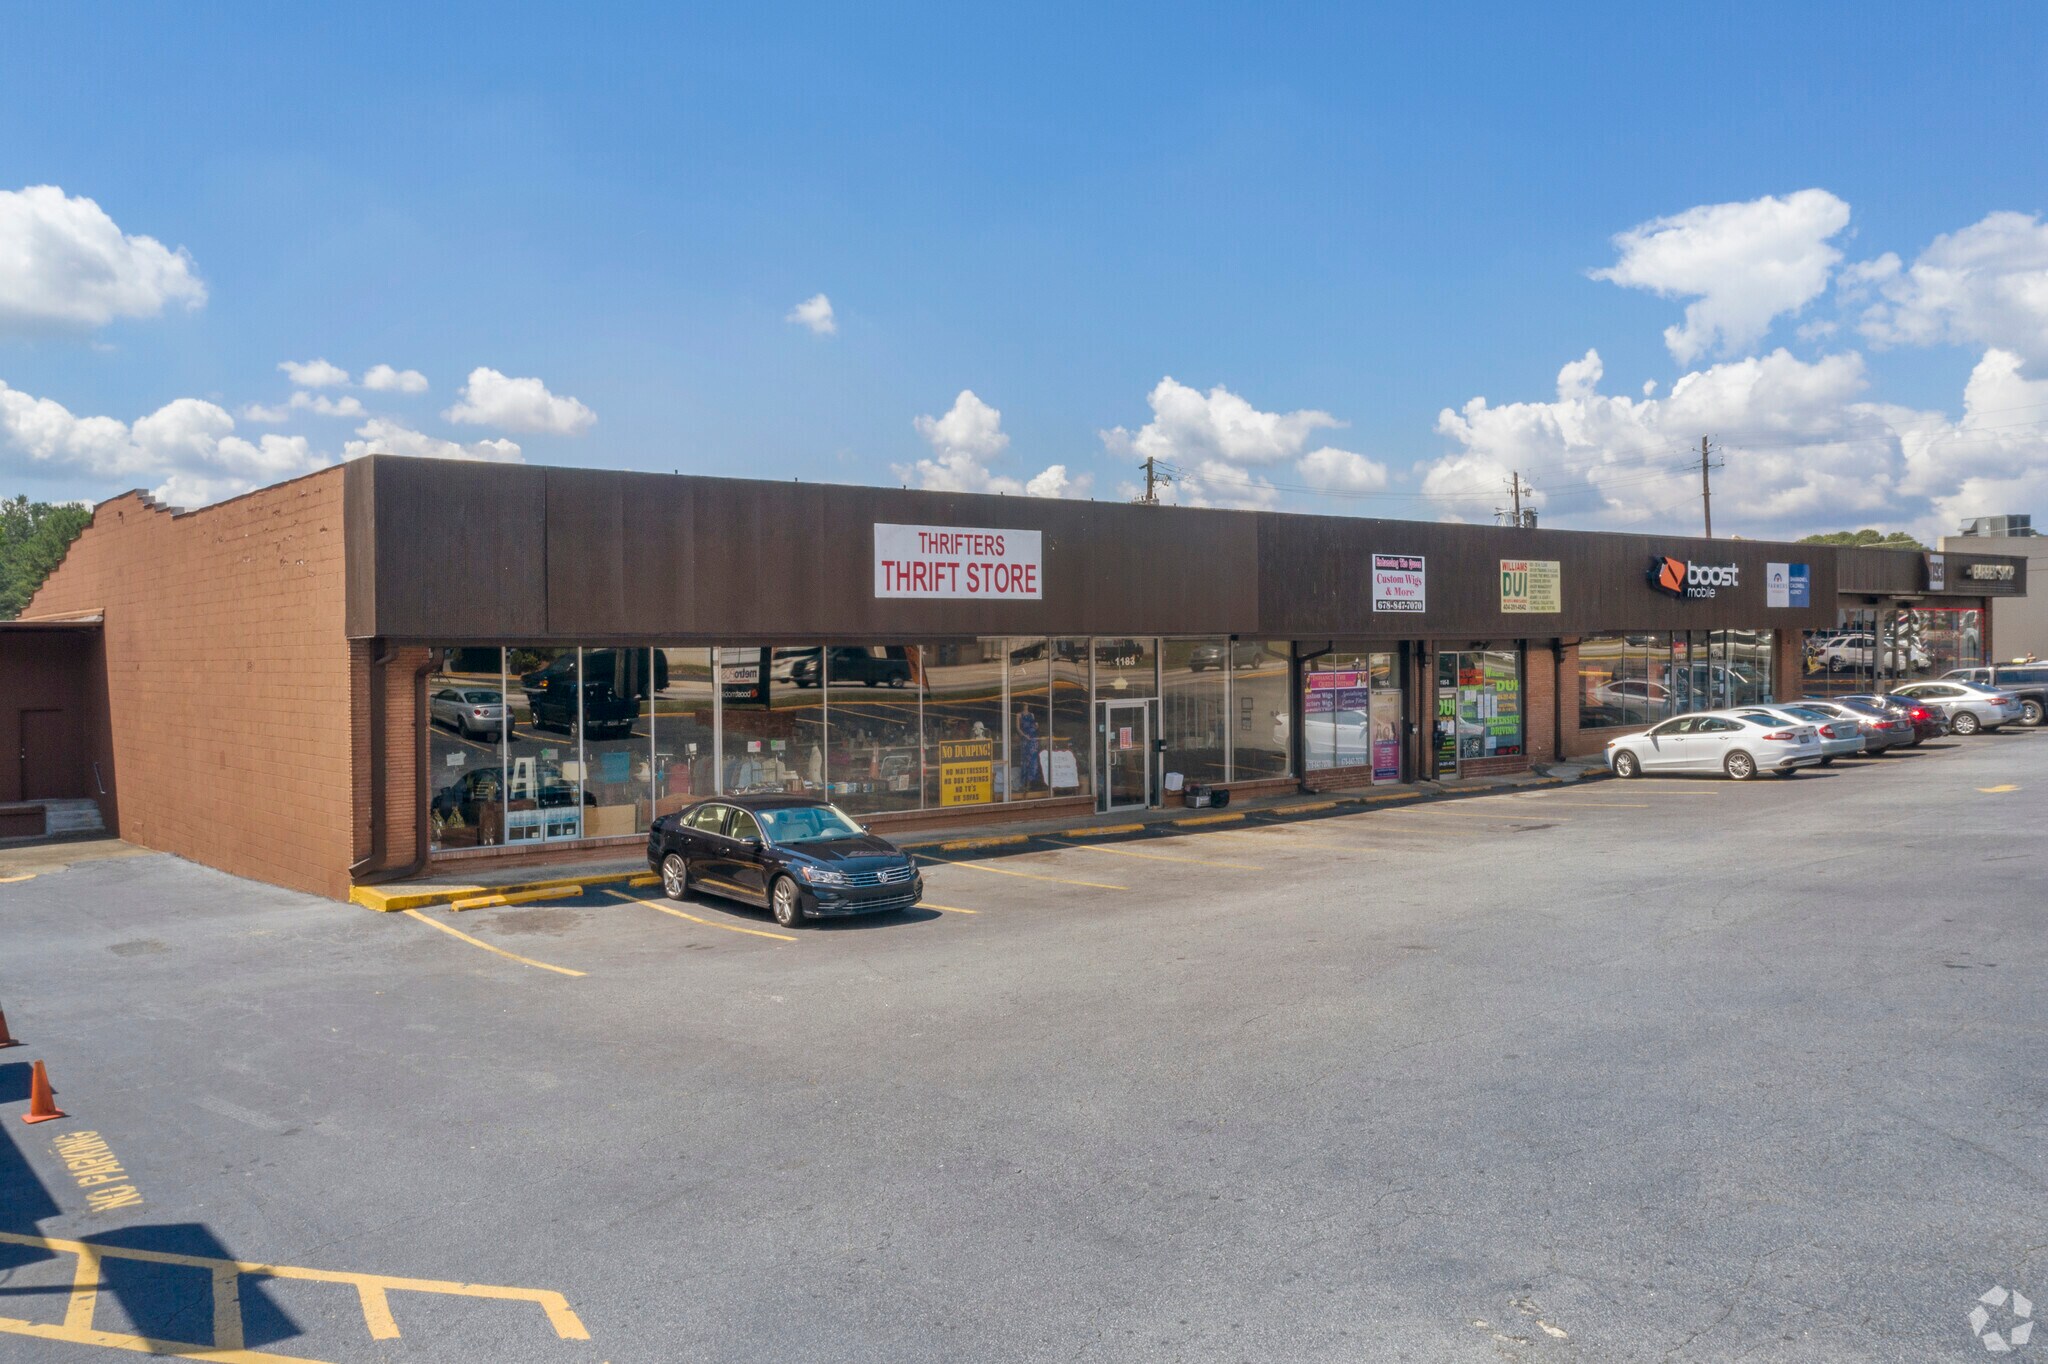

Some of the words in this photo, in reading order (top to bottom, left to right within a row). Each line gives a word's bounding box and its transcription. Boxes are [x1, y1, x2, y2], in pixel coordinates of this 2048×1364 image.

[918, 531, 1005, 557] THRIFTERS
[1502, 562, 1528, 571] WILLIAMS
[881, 560, 960, 592] THRIFT
[966, 562, 1037, 593] STORE
[1687, 560, 1739, 587] boost
[1376, 573, 1404, 584] Custom
[1405, 574, 1422, 588] Wigs
[1502, 572, 1528, 597] DUI
[1385, 586, 1392, 596] &
[1394, 587, 1415, 596] More
[1687, 586, 1716, 598] mobile
[1377, 600, 1422, 610] 678-847-7070
[1115, 656, 1136, 666] 1183
[1496, 679, 1519, 692] DUI
[1490, 726, 1517, 736] DRIVING
[942, 745, 953, 759] NO
[955, 742, 991, 758] DUMPING!
[955, 766, 989, 774] MATTRESSES
[963, 793, 979, 801] SOFAS
[52, 1131, 129, 1188] PARKING
[86, 1184, 144, 1213] NO
